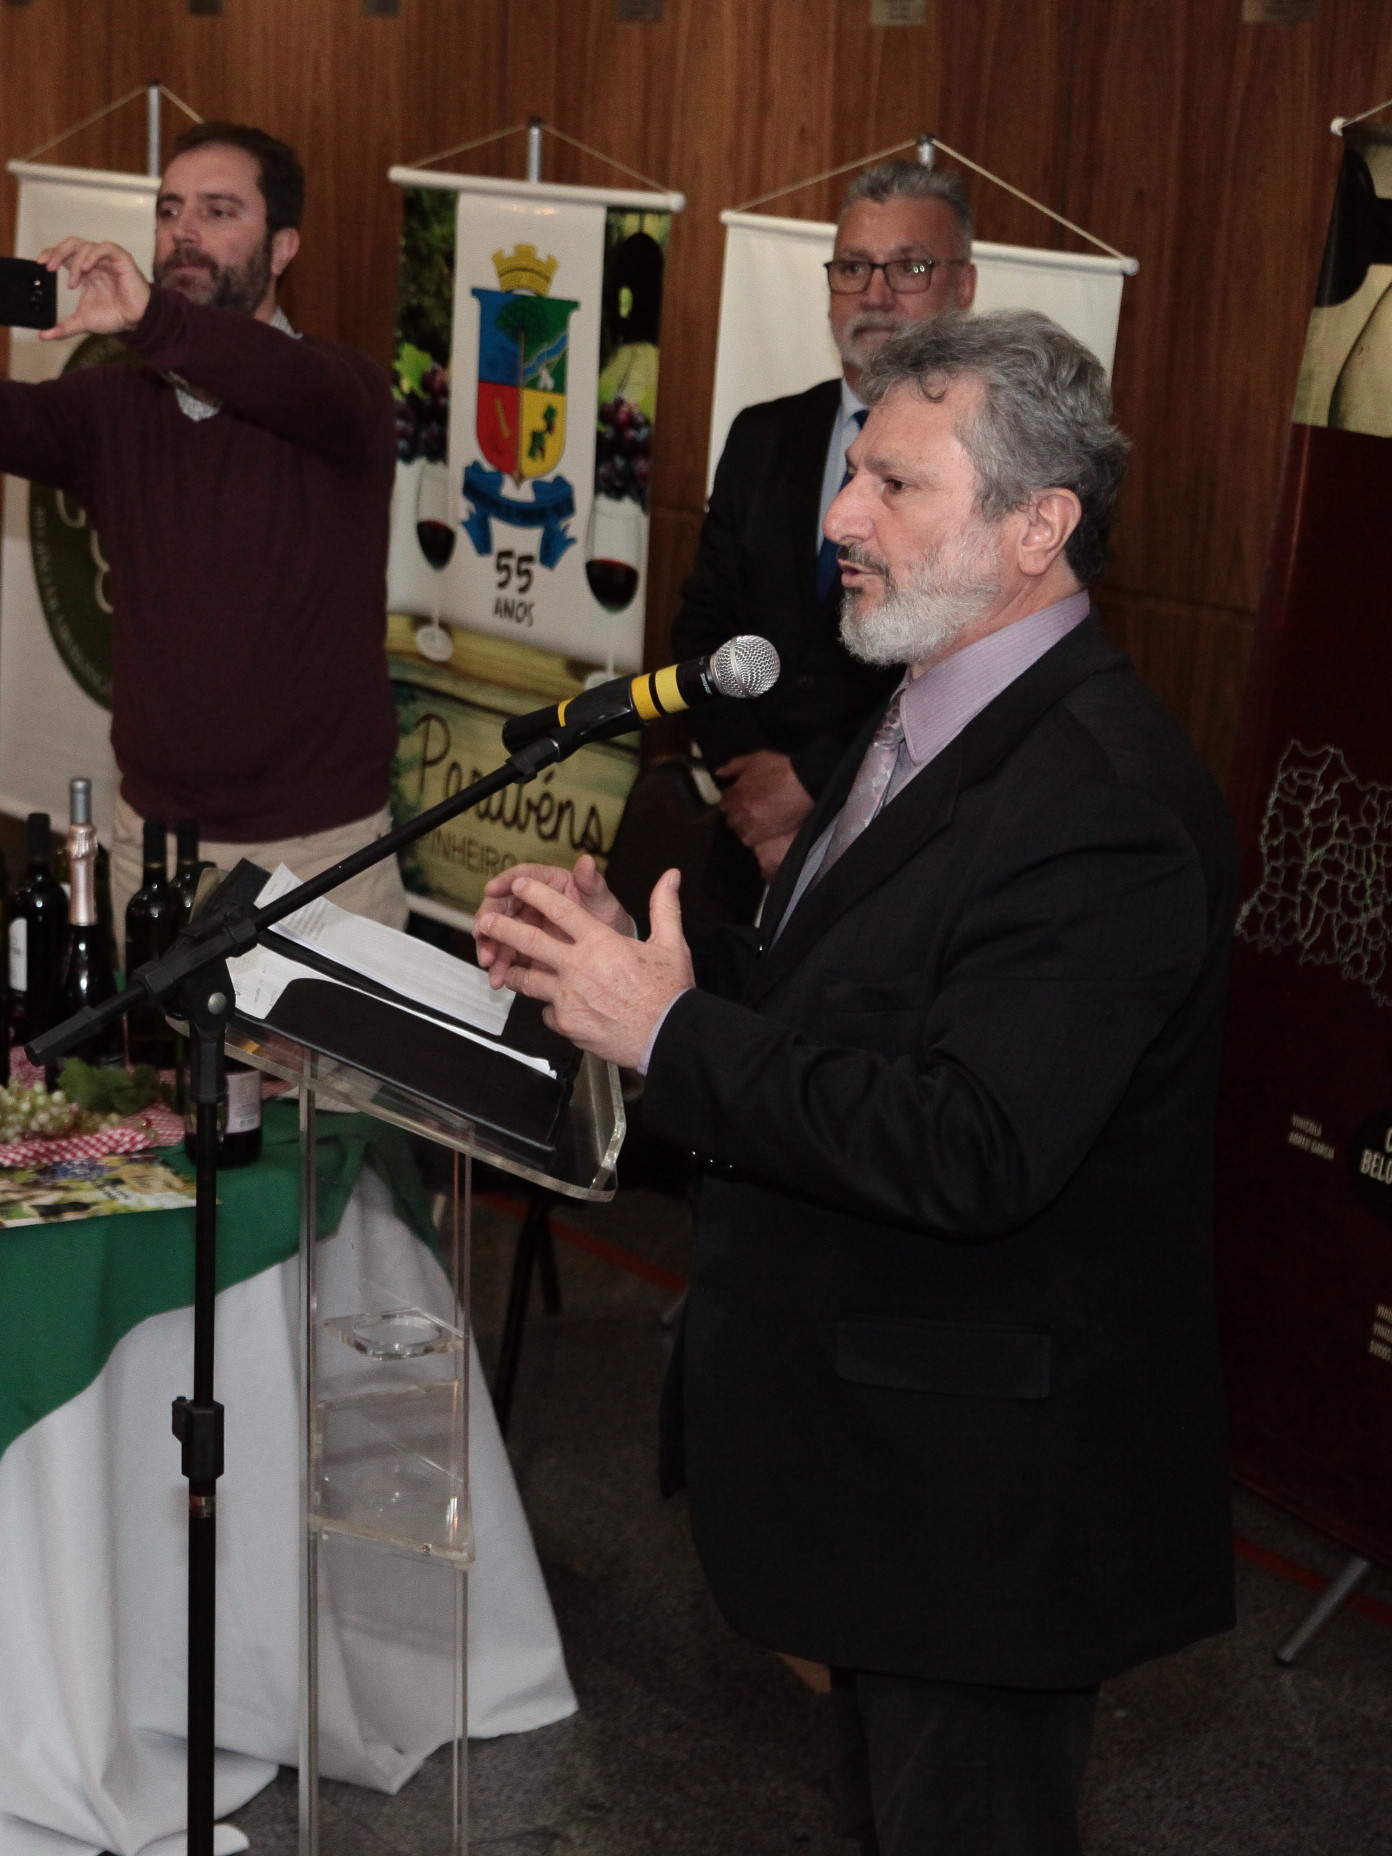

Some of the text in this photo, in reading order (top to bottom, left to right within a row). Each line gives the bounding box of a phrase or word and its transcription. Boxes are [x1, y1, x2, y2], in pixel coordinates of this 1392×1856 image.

[495, 551, 535, 594] 55
[494, 598, 535, 627] ANOS
[420, 828, 517, 875] INHEIRO
